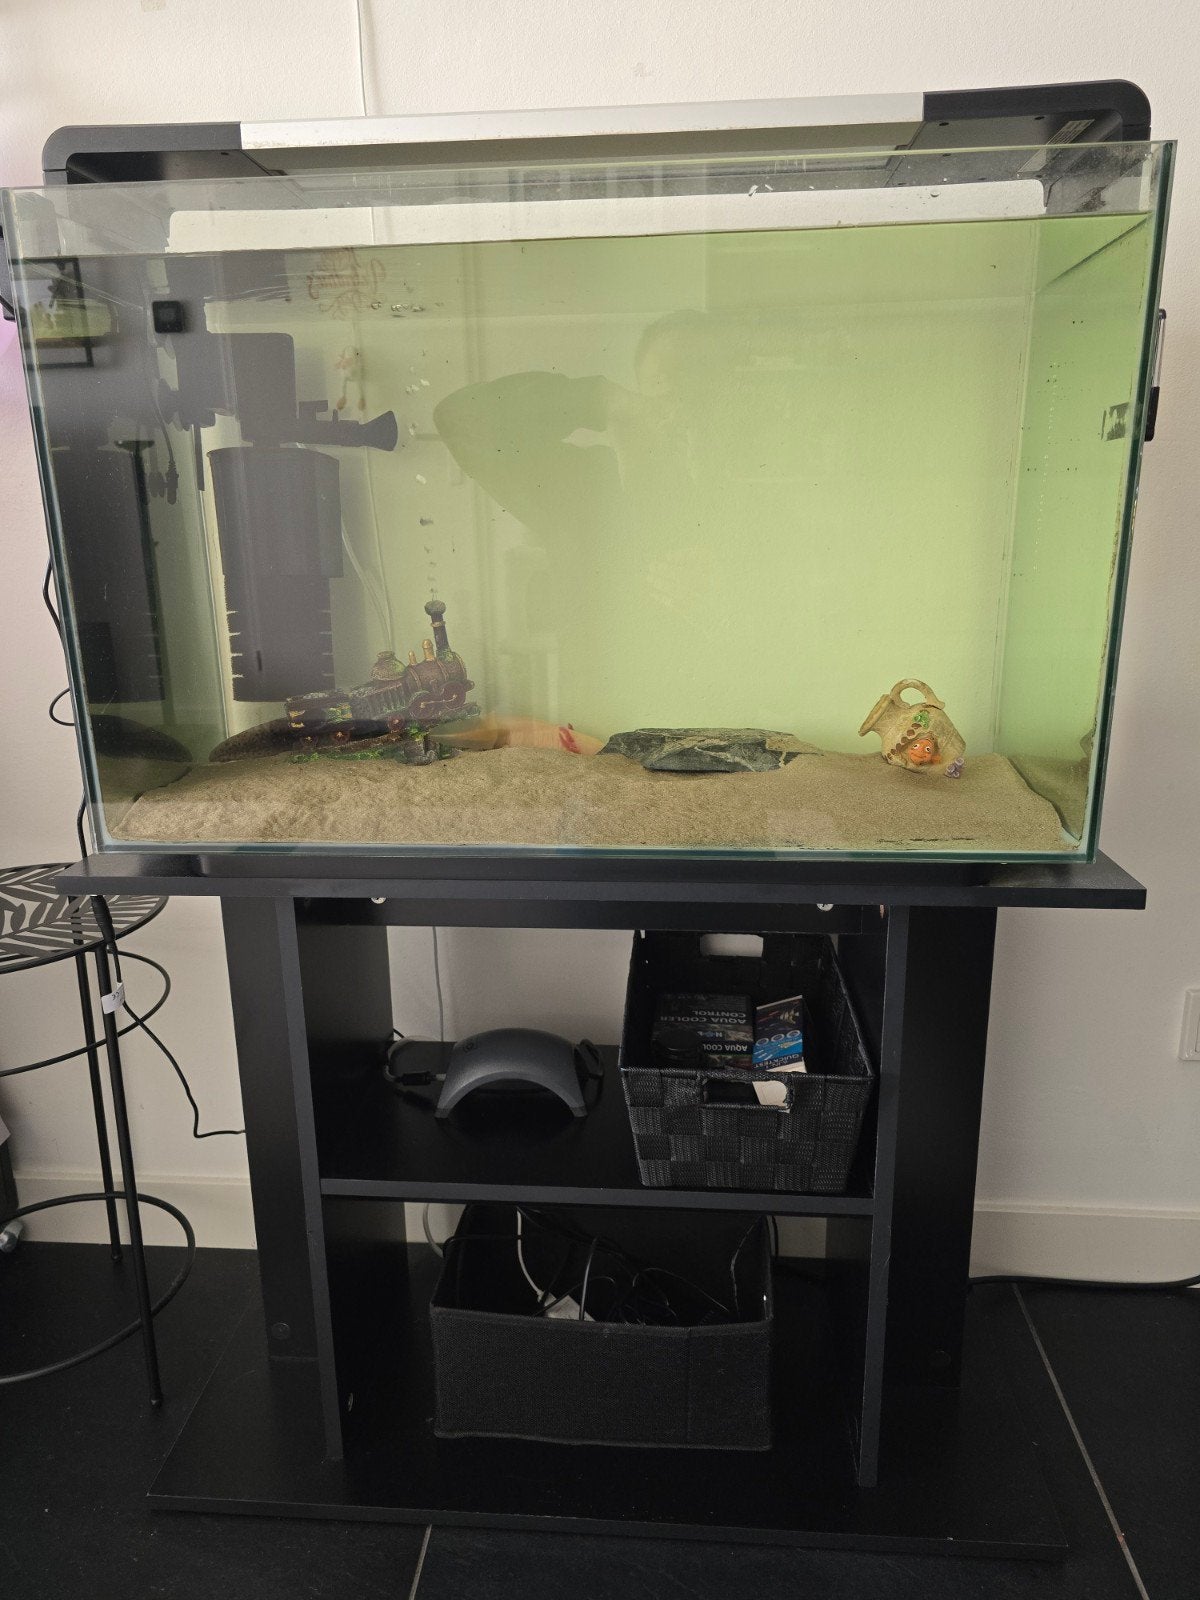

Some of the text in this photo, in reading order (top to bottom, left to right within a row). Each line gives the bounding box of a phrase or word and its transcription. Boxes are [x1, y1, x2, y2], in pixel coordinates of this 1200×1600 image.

[691, 1010, 746, 1018] CONTROL
[702, 1043, 748, 1052] AQUA COOL
